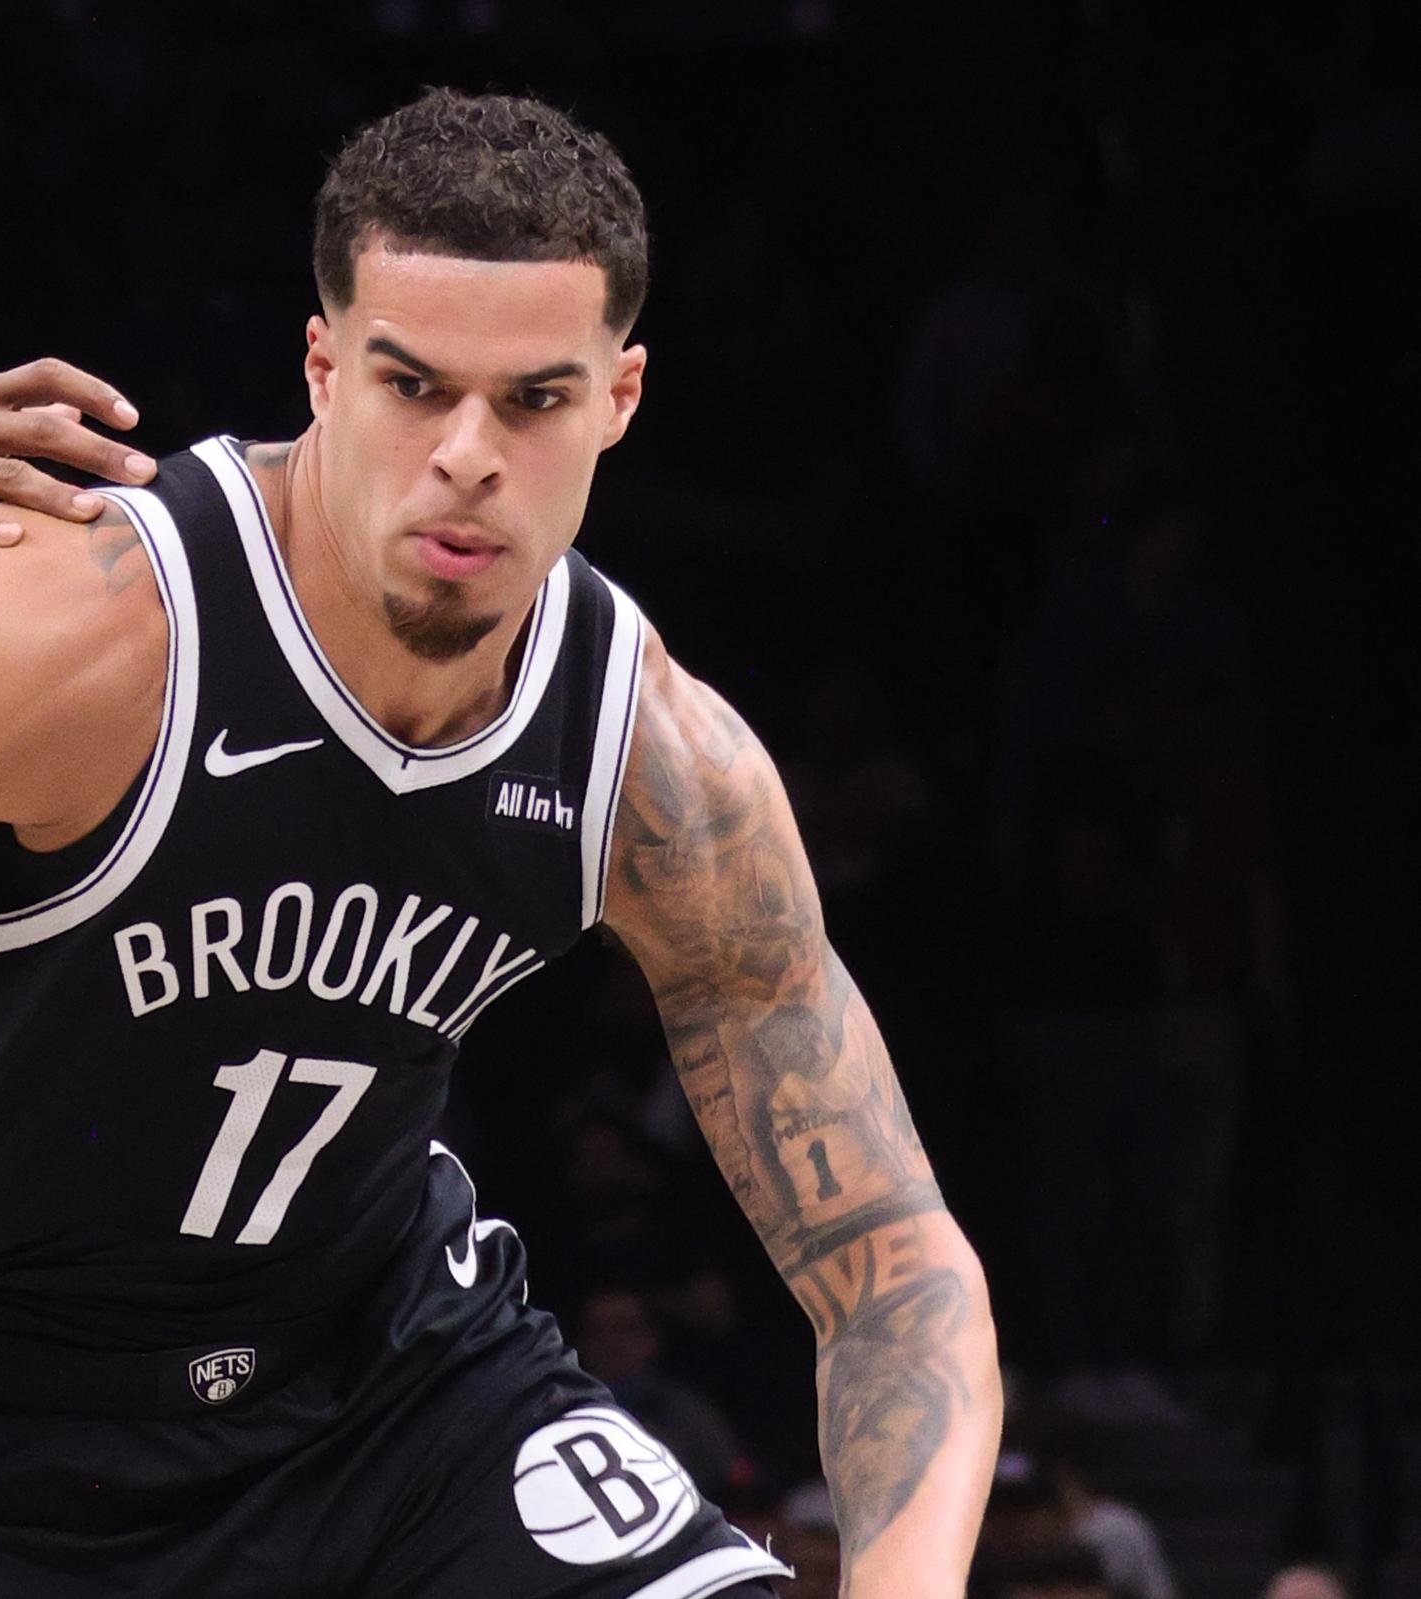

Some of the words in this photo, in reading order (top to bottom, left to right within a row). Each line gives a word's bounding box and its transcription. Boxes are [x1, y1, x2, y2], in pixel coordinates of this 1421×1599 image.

[495, 782, 524, 816] All
[526, 786, 551, 822] In
[180, 1048, 377, 1245] 17
[807, 1138, 842, 1201] 1
[196, 1354, 249, 1385] NETS
[553, 1432, 659, 1539] B
